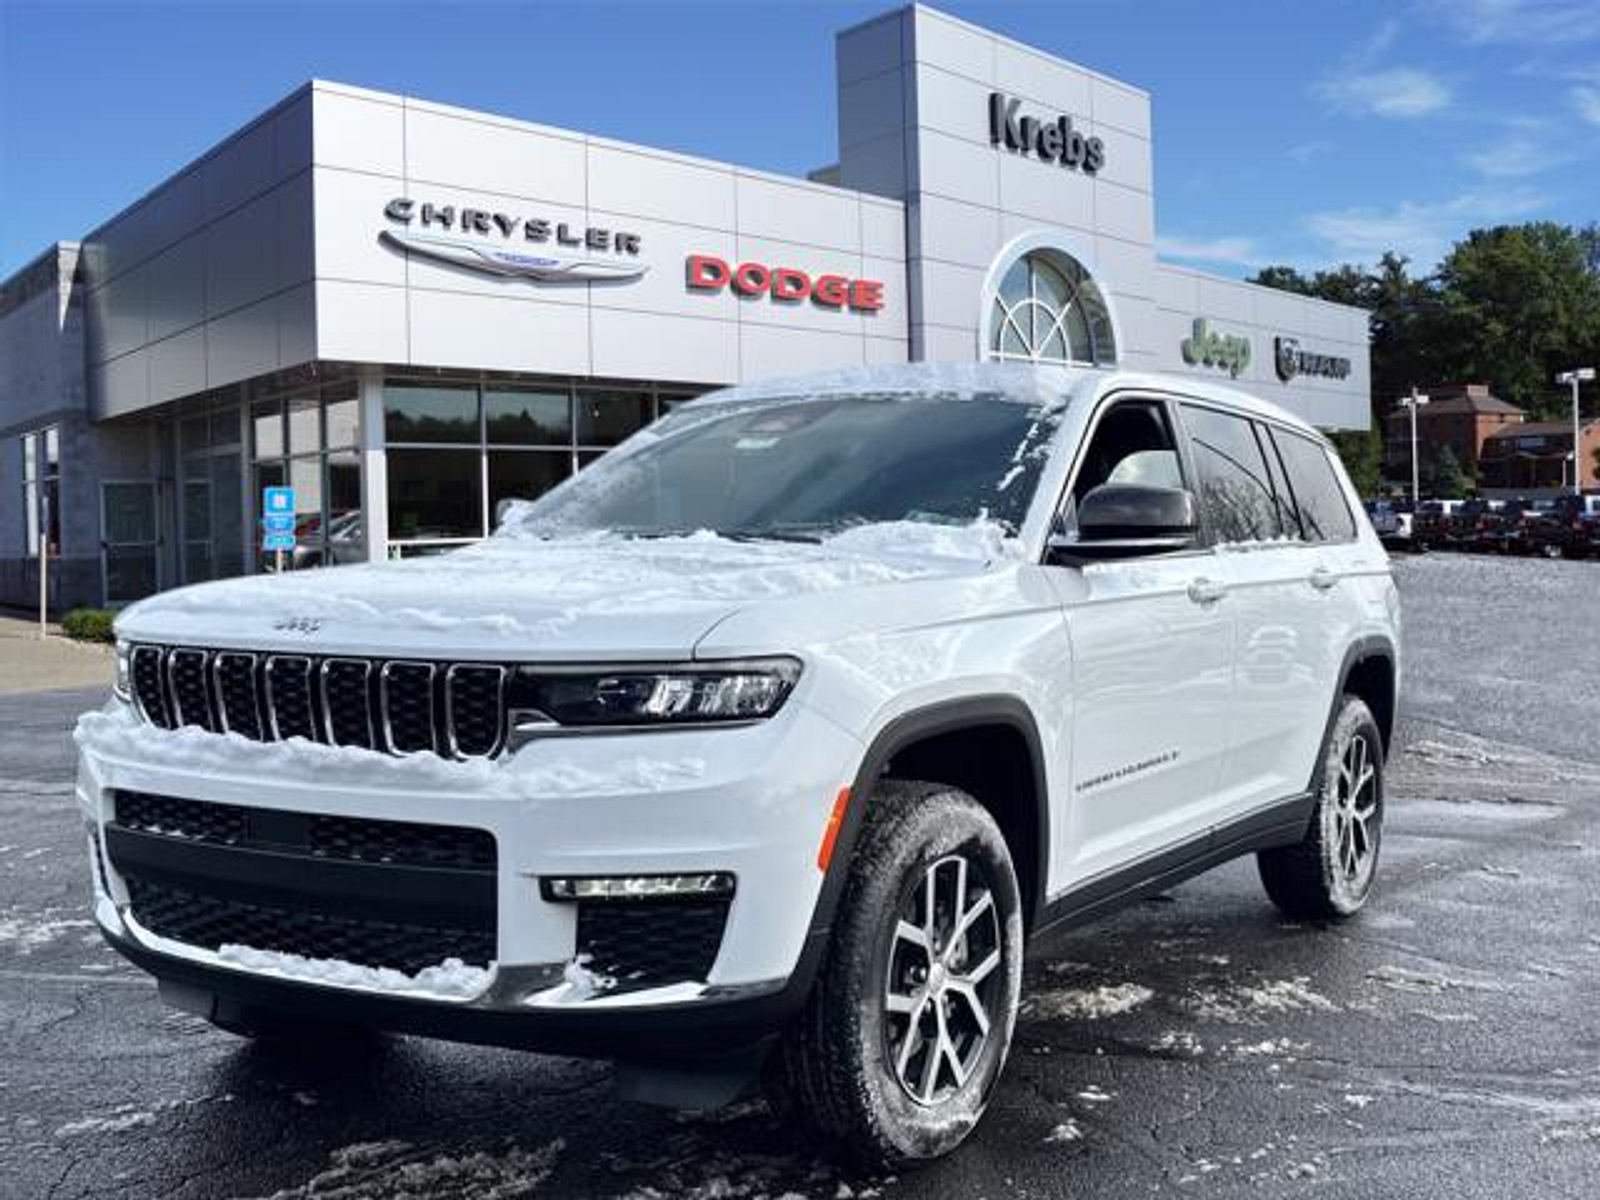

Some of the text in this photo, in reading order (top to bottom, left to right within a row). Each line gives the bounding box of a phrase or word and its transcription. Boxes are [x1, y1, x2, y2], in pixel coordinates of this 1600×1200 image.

[988, 92, 1105, 174] Krebs
[383, 197, 642, 255] CHRYSLER
[685, 254, 885, 314] DODGE
[1179, 318, 1251, 380] Jeep
